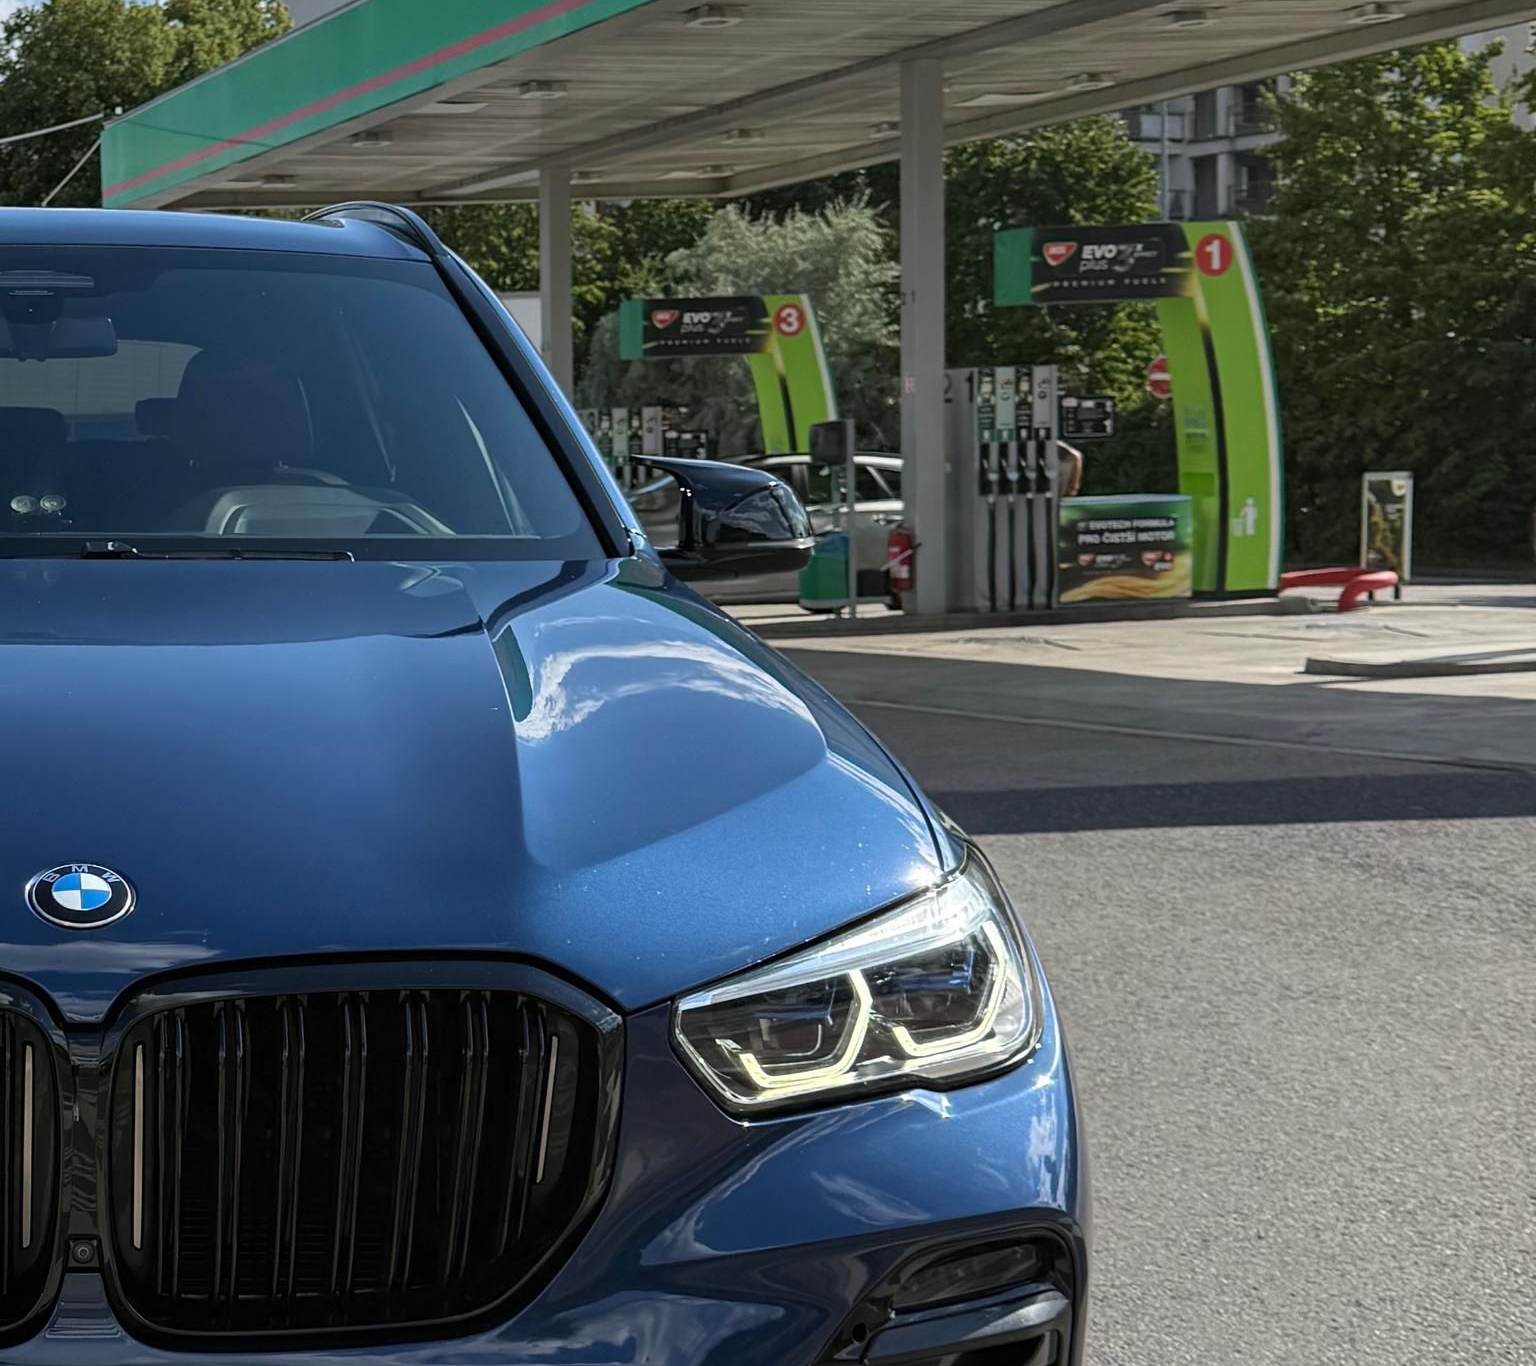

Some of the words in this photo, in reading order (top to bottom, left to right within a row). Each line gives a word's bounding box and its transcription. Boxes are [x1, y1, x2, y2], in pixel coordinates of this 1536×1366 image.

[1081, 244, 1118, 259] EVO
[1205, 239, 1221, 270] 1
[1079, 259, 1109, 273] plus
[1053, 279, 1116, 287] PREMIUM
[683, 312, 712, 324] EVO
[779, 307, 799, 333] 3
[965, 371, 974, 403] 1
[43, 864, 120, 883] BMW
